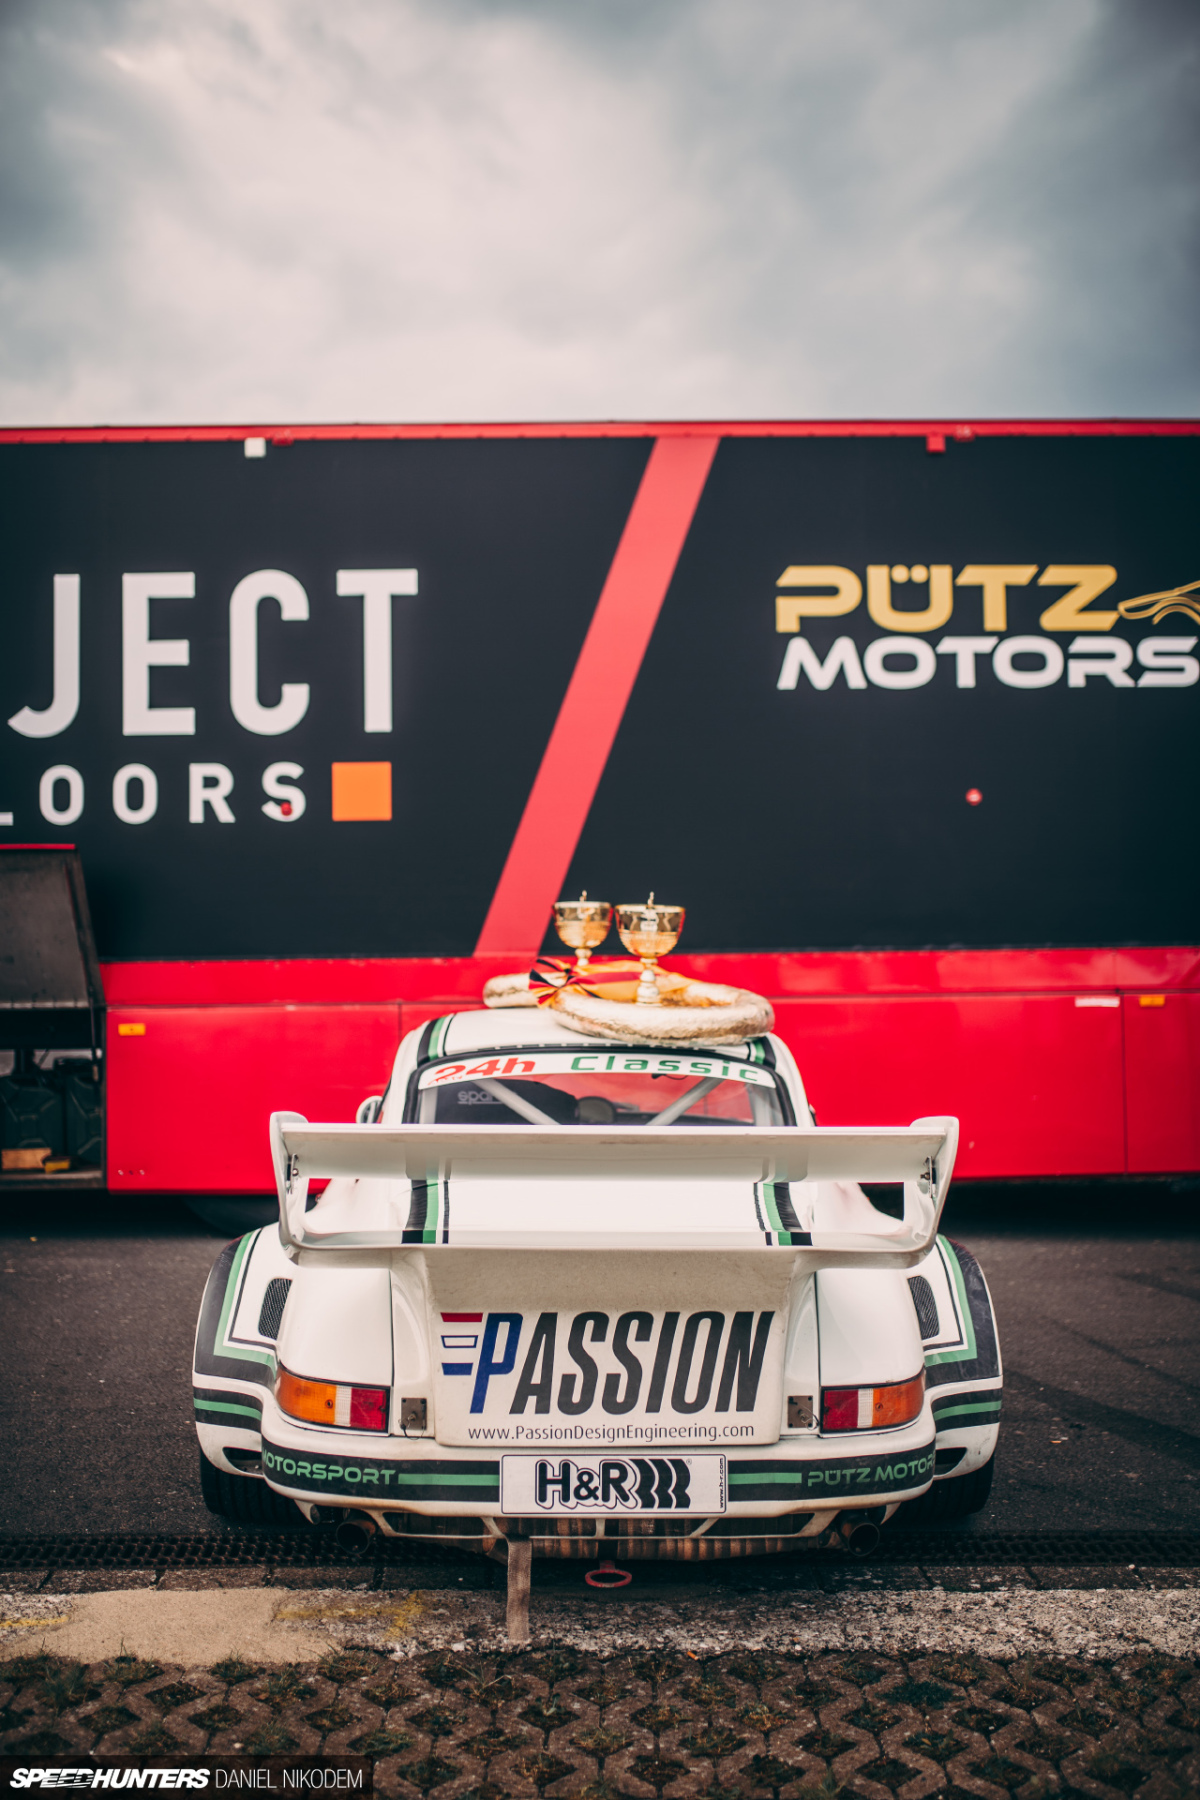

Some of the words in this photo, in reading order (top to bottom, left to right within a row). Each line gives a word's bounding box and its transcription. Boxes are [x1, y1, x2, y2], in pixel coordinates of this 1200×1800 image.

[776, 564, 1119, 633] PÜTZ
[7, 568, 419, 738] JECT
[776, 635, 1200, 690] MOTORS
[0, 761, 307, 826] OORS
[428, 1057, 536, 1085] 24h
[571, 1054, 759, 1082] Classic
[457, 1091, 494, 1105] spa
[469, 1310, 776, 1415] PASSION
[468, 1424, 755, 1443] www.PassionDesignEngineering.com
[535, 1459, 635, 1508] H&R
[807, 1466, 872, 1487] PÜTZ
